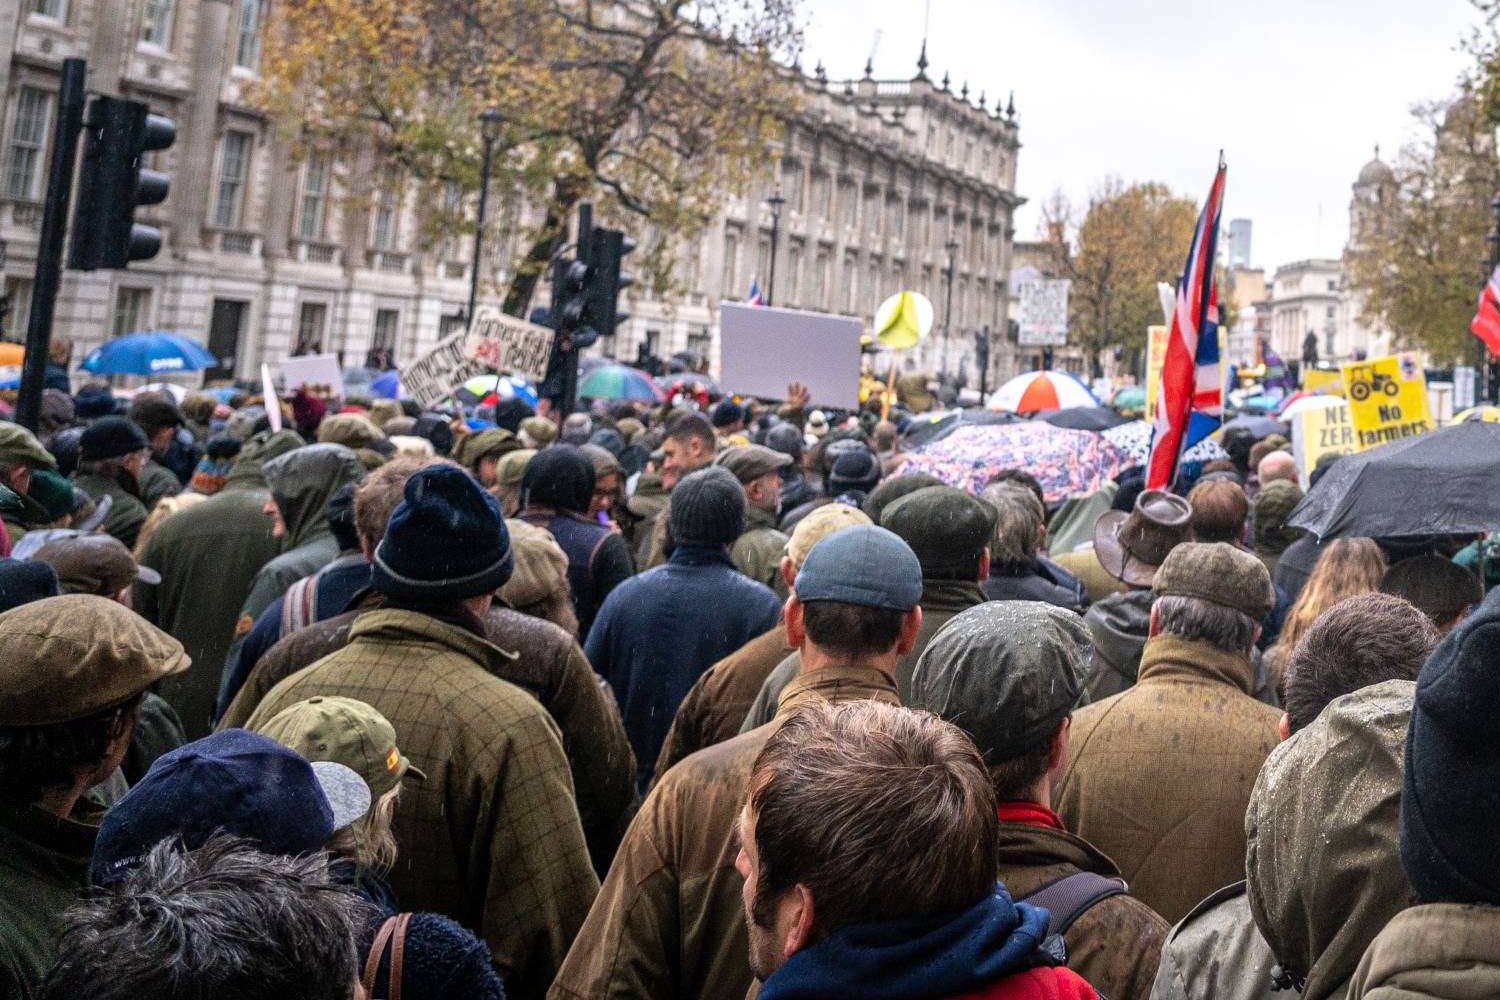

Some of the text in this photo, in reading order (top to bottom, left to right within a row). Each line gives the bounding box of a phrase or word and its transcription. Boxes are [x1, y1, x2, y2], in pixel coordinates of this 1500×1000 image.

[1325, 406, 1349, 424] NE
[1378, 405, 1401, 422] No
[1320, 427, 1354, 448] ZER
